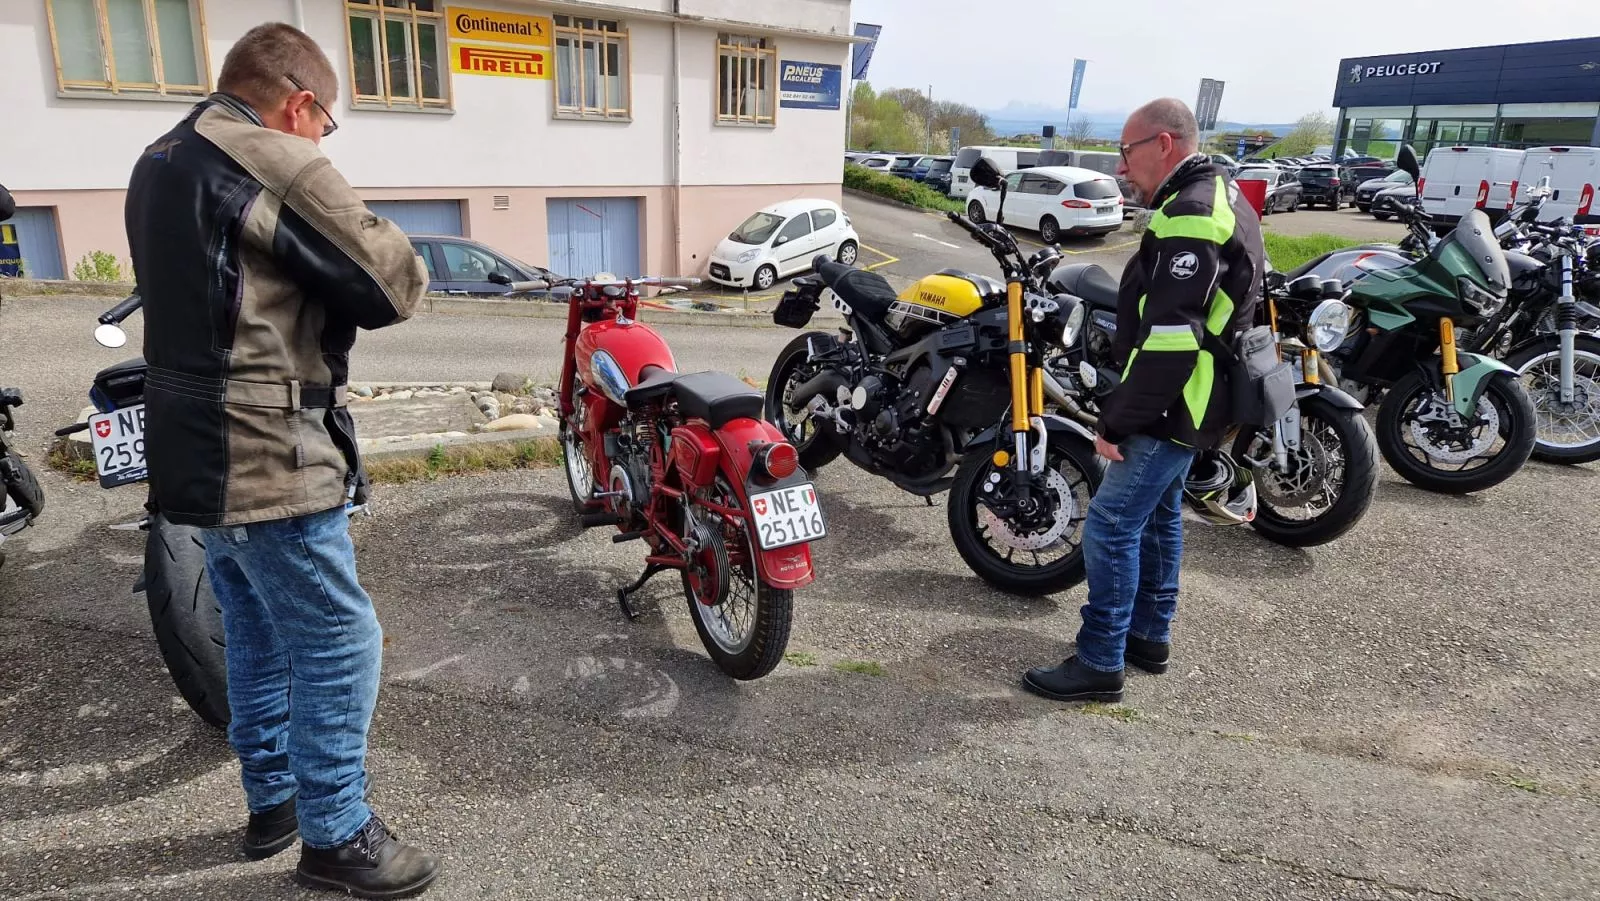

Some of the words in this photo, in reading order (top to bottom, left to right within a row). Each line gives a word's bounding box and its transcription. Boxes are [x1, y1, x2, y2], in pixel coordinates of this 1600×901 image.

[456, 14, 531, 36] Continental
[460, 47, 543, 75] PIRELLI
[1366, 62, 1441, 77] PEUGEOT
[783, 65, 823, 81] PNEUS
[920, 292, 946, 306] YAMAHA
[771, 489, 800, 515] NE
[761, 512, 823, 546] 25116
